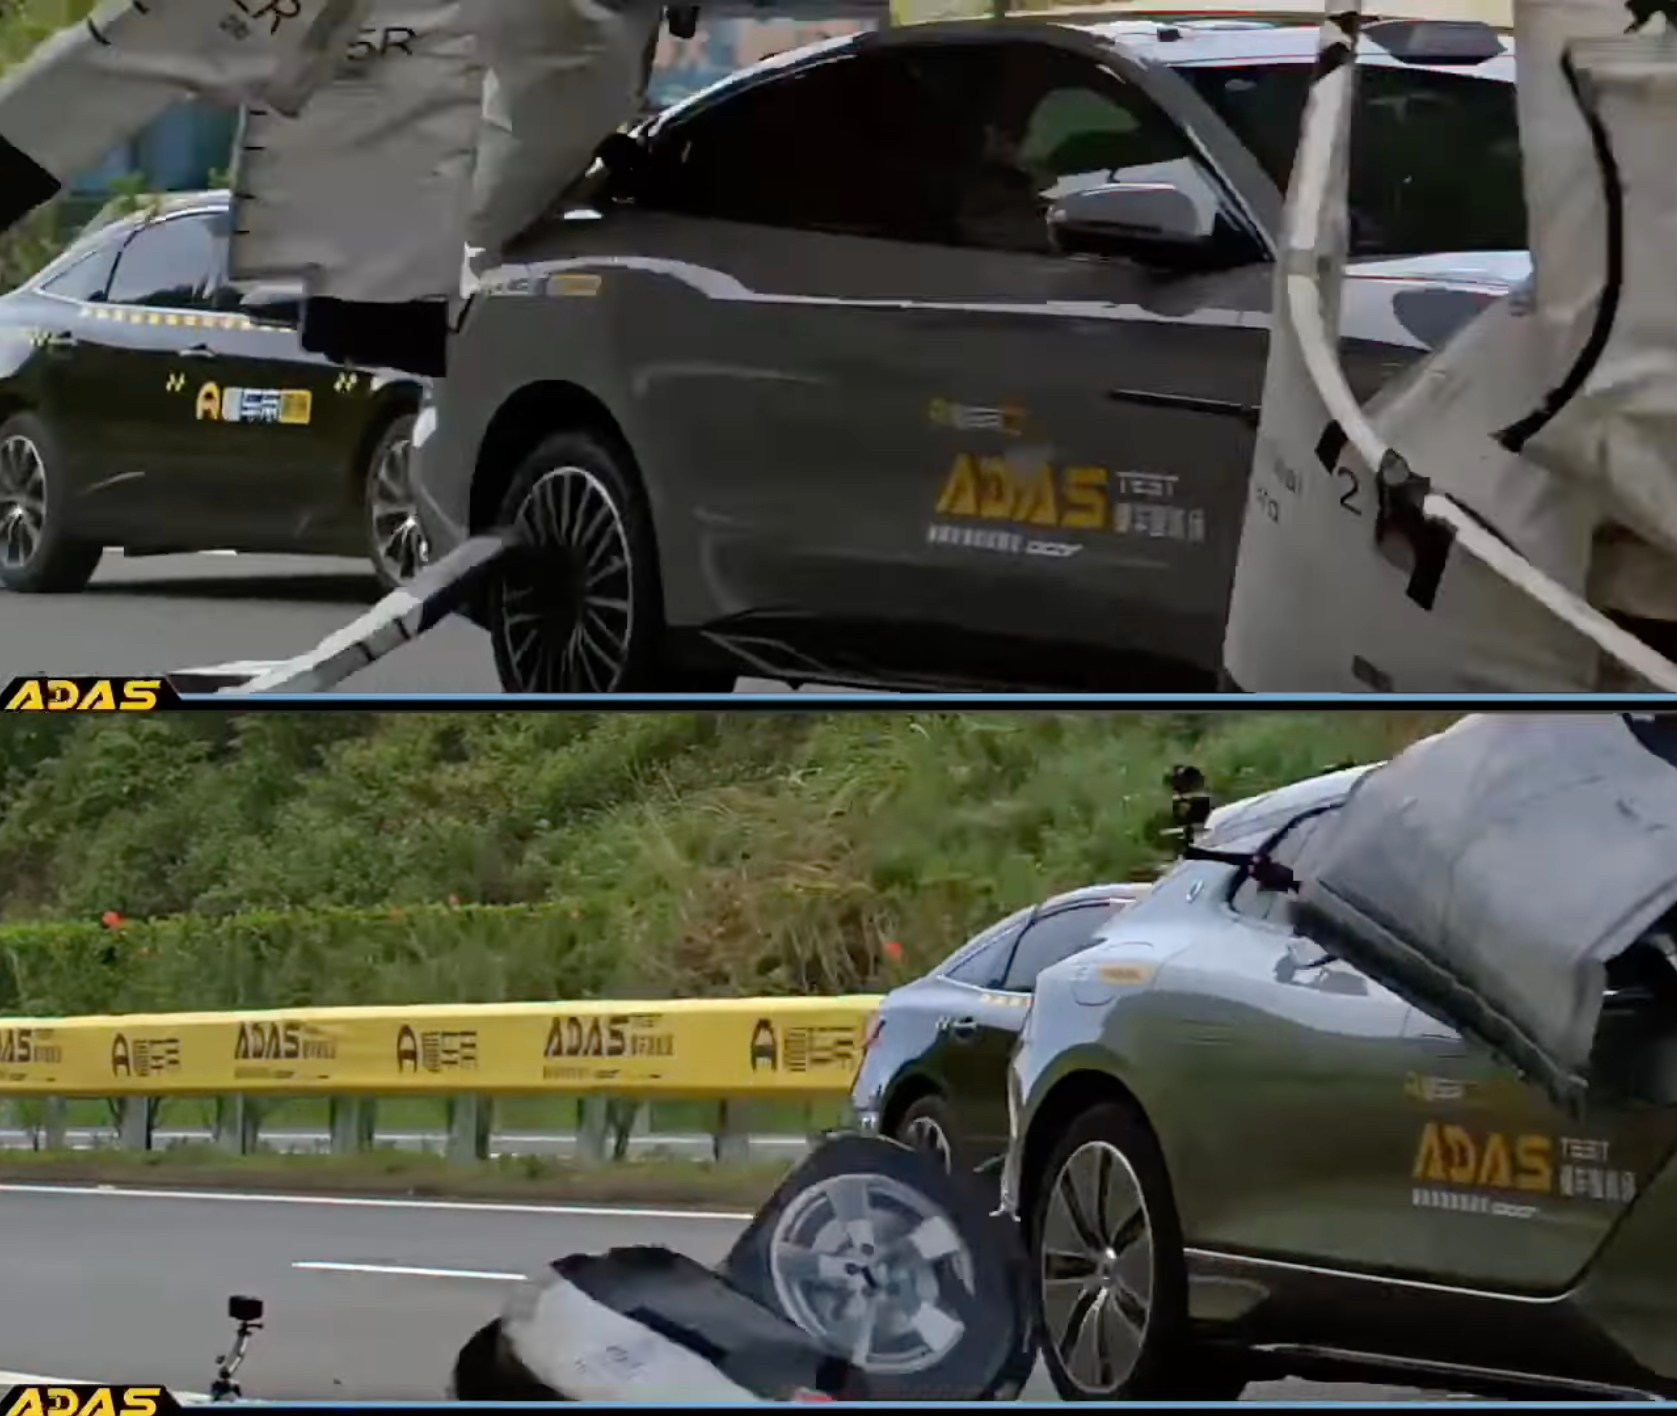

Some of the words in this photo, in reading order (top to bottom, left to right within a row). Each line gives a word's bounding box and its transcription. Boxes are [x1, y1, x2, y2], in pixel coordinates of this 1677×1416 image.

[234, 1021, 300, 1059] ADAS
[543, 1016, 629, 1057] ADAS
[1412, 1122, 1553, 1192] ADAS
